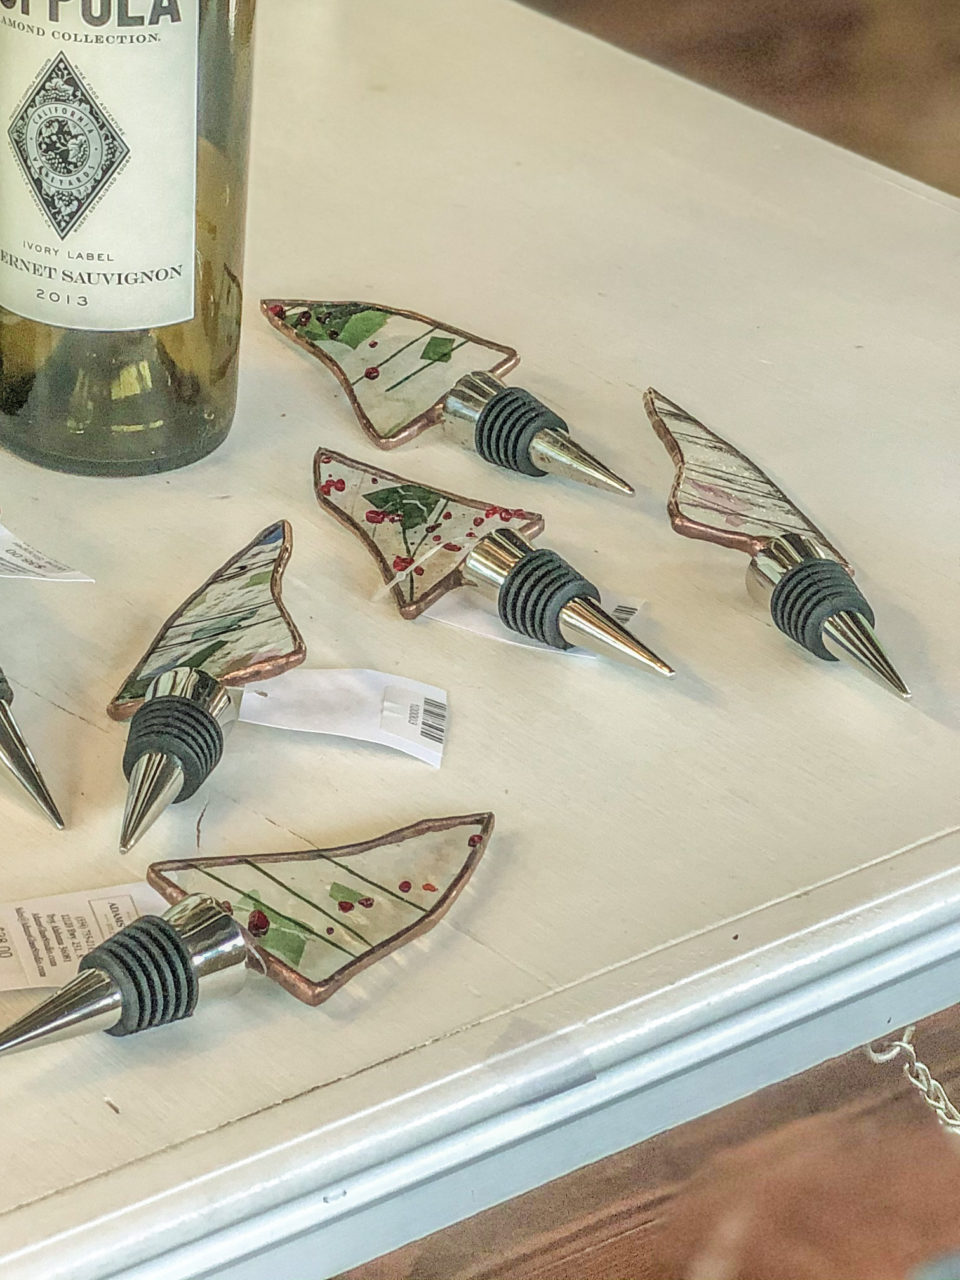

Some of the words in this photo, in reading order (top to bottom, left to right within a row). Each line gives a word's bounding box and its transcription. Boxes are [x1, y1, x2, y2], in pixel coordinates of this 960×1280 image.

[33, 106, 94, 135] CALIFORNIA
[22, 240, 60, 257] IVORY
[67, 251, 115, 262] LABEL
[61, 265, 183, 285] SAUVIGNON
[36, 289, 89, 307] 2013
